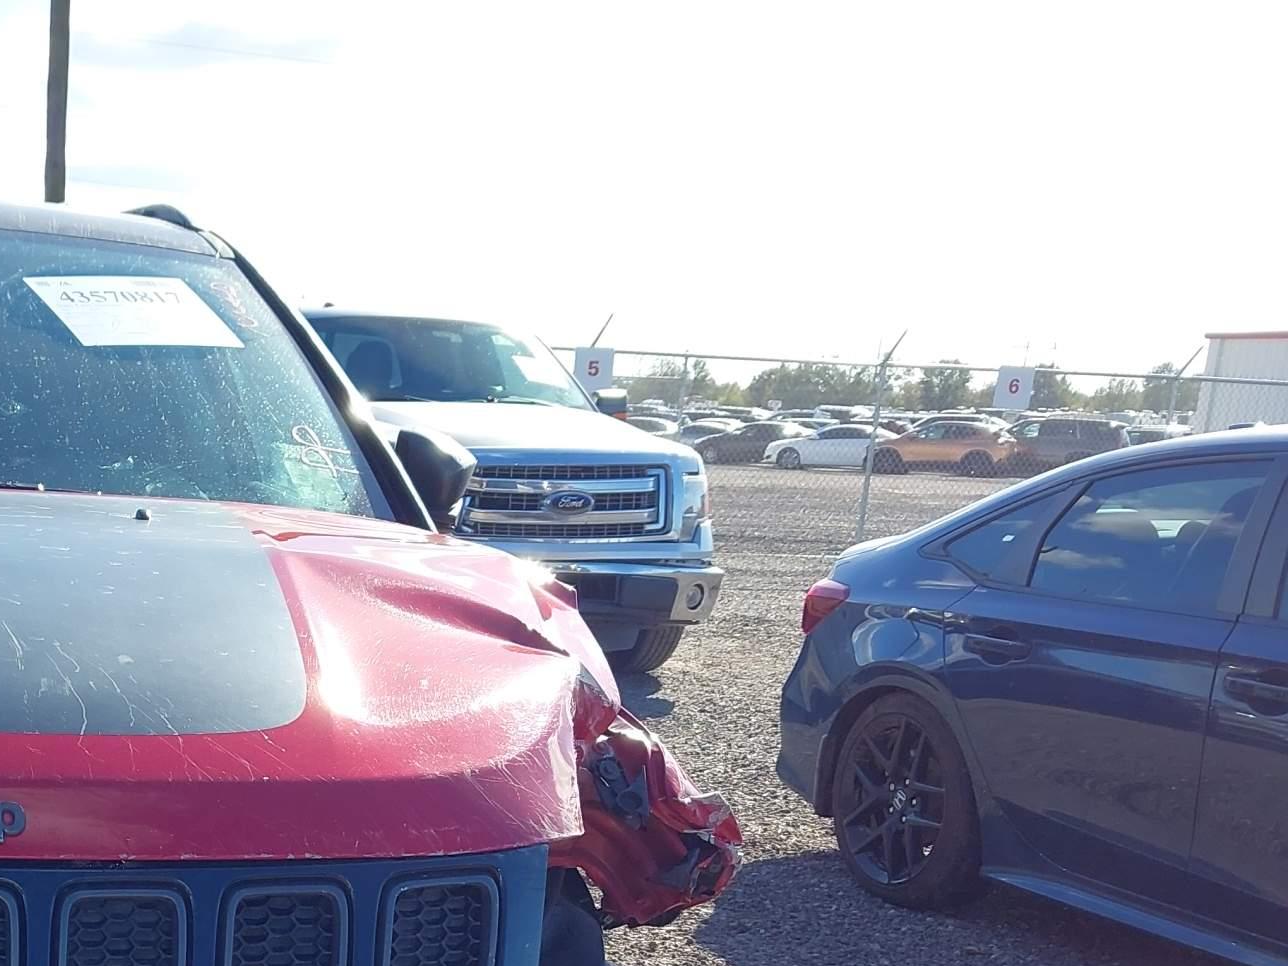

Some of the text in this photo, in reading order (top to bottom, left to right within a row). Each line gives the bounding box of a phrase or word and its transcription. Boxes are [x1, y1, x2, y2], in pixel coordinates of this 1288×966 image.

[59, 290, 181, 303] 43570817
[587, 359, 600, 377] 5
[1008, 378, 1021, 394] 6
[557, 495, 585, 508] Ford
